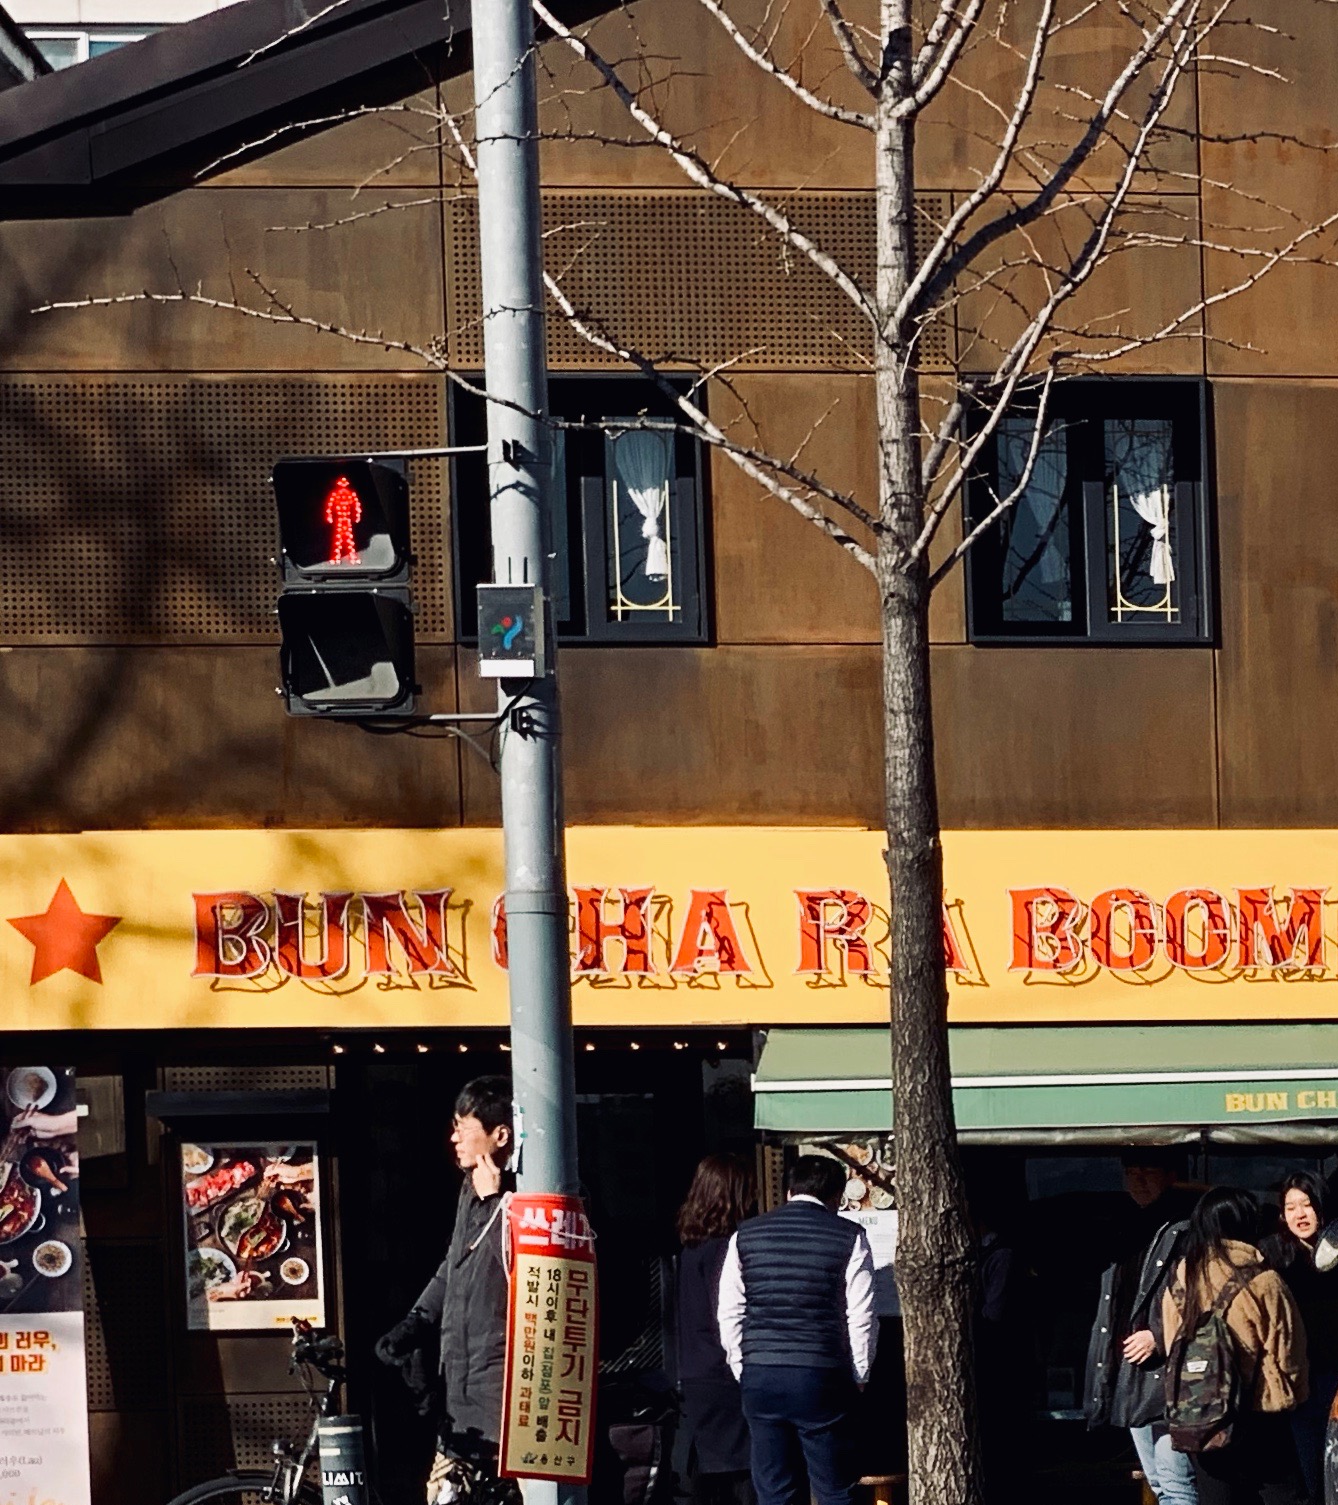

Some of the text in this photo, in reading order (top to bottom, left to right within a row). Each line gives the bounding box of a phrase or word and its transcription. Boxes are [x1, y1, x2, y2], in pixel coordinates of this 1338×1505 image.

[191, 887, 457, 981] BUN
[491, 886, 755, 976] HA
[1007, 885, 1331, 973] BOOM
[1225, 1092, 1289, 1113] BUN
[10, 1354, 46, 1372] 마라
[554, 1269, 589, 1446] 무단투기 금지
